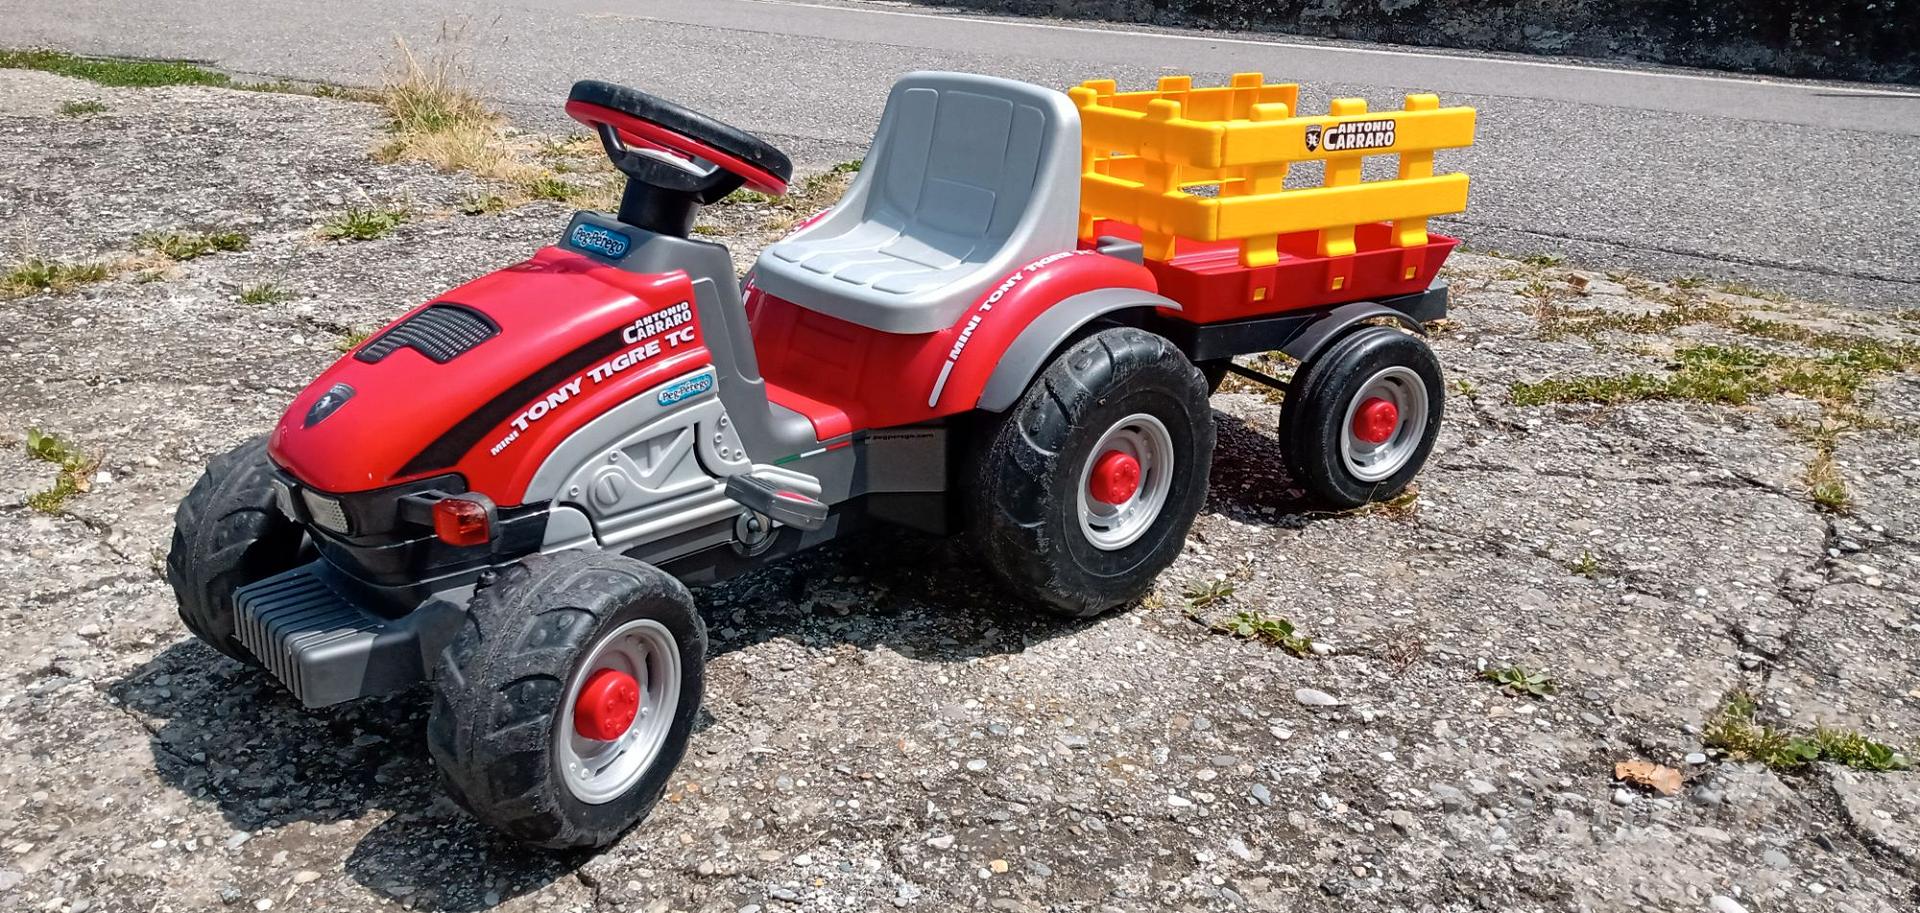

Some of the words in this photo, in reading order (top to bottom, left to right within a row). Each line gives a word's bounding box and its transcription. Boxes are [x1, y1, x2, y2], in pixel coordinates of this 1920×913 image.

[1323, 128, 1395, 151] CARRARO
[1338, 120, 1395, 134] ANTONIO
[622, 308, 692, 344] CARRARO
[635, 301, 689, 328] ANTONIO
[948, 314, 982, 361] MINI
[979, 272, 1023, 313] TONY
[490, 430, 519, 456] MINI
[511, 376, 582, 431] TONY
[586, 339, 661, 384] TIGRE
[664, 326, 695, 347] TC
